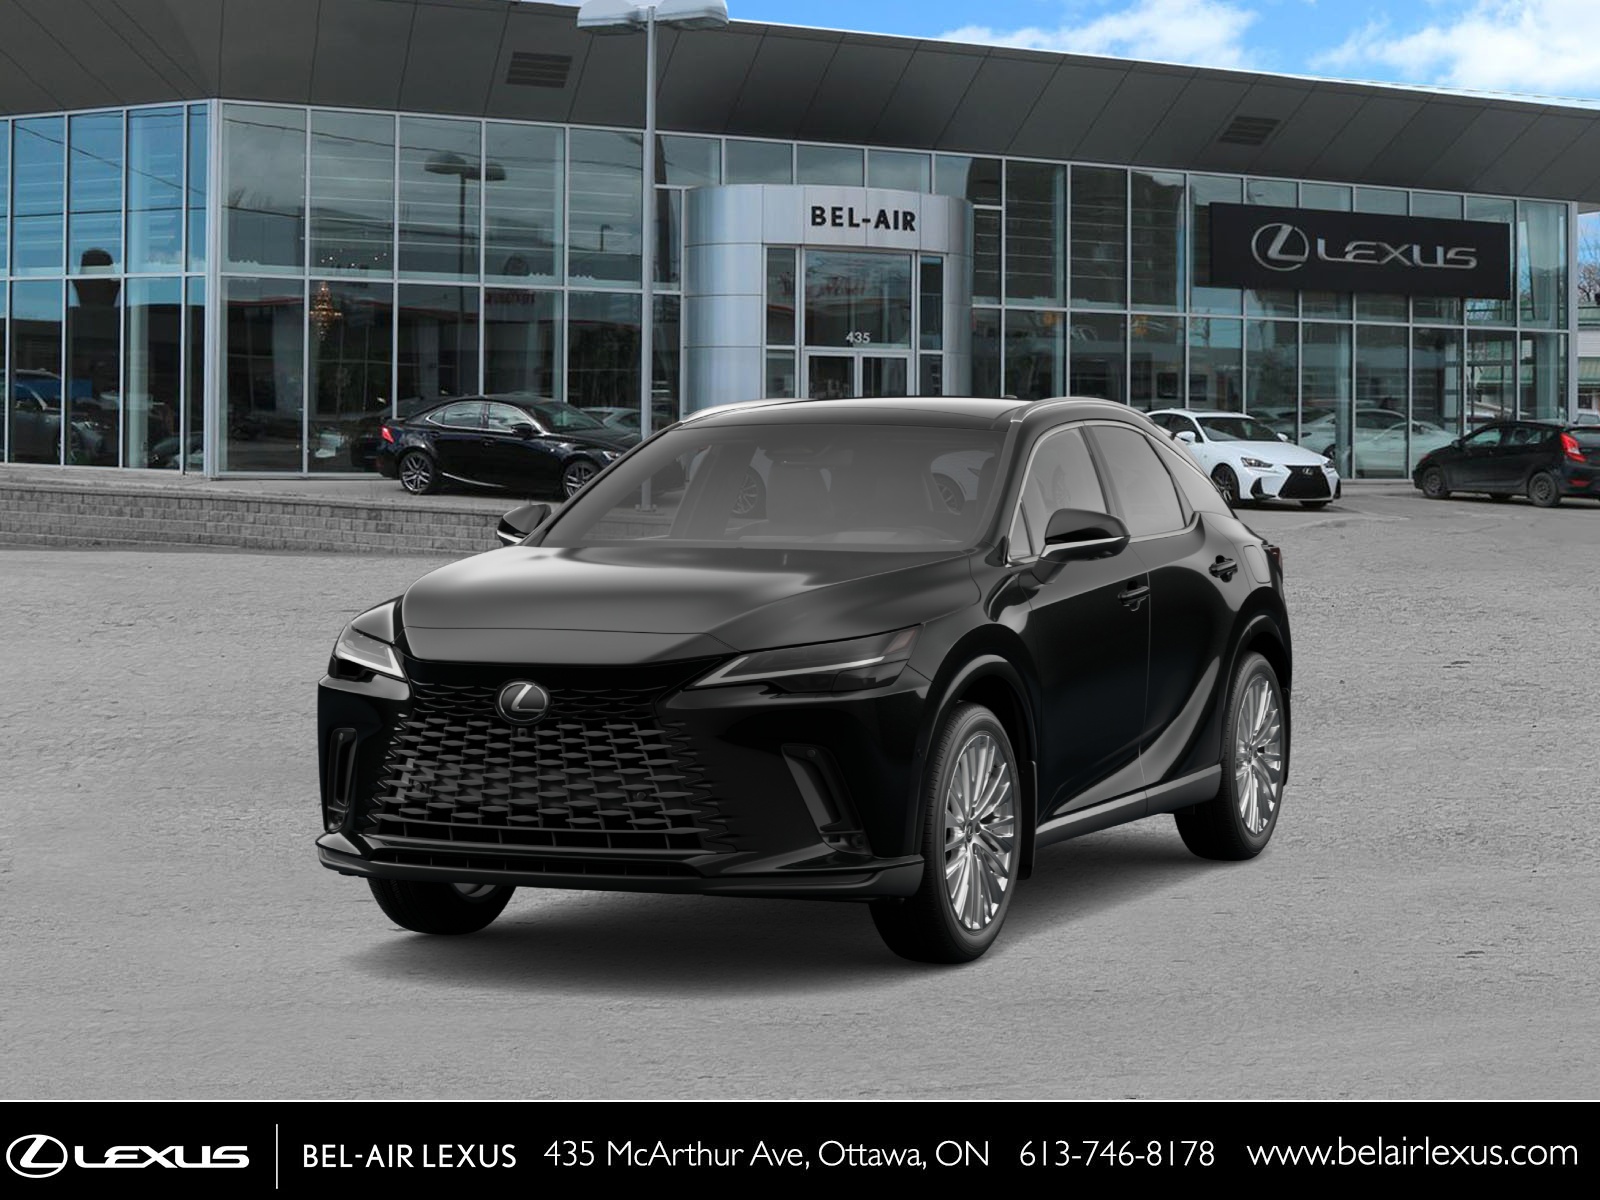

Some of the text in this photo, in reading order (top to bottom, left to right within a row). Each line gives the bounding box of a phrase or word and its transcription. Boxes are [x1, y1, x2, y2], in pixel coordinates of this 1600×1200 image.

[811, 205, 916, 232] BEL-AIR
[1317, 237, 1478, 270] LEXUS
[846, 331, 871, 344] 435
